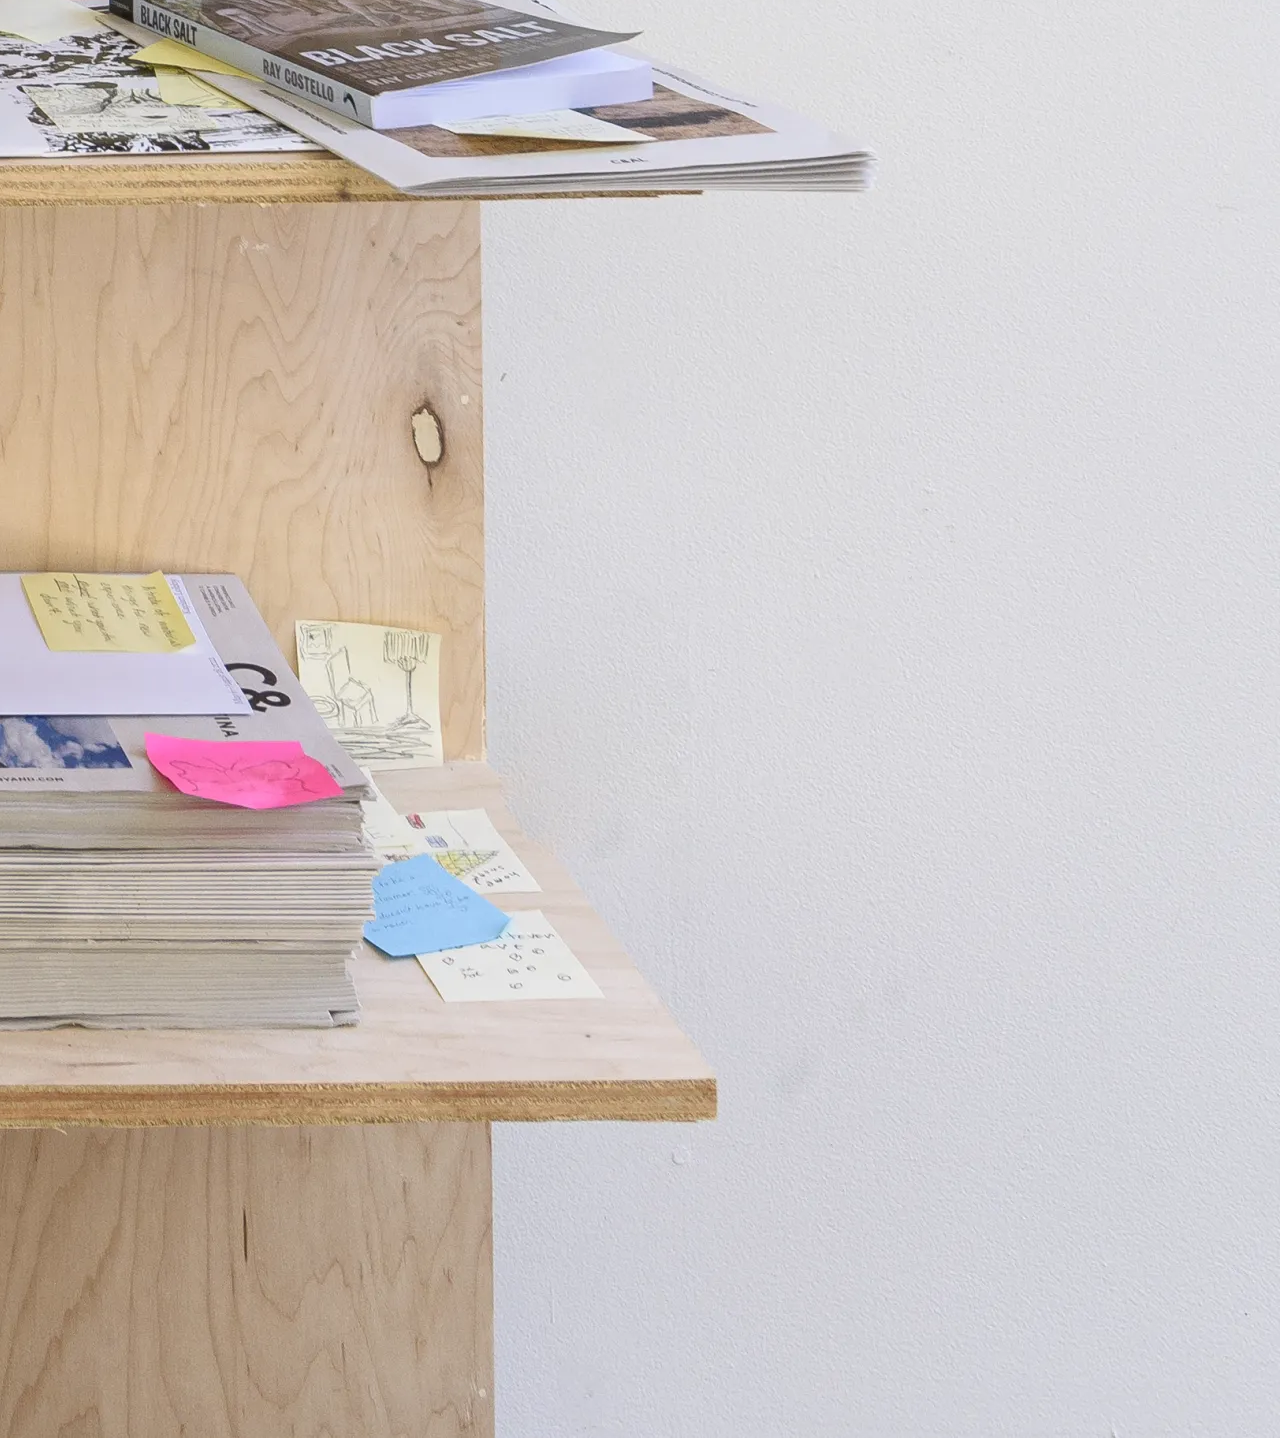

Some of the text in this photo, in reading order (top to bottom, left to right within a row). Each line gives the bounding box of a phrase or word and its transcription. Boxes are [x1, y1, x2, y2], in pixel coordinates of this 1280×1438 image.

[140, 5, 197, 47] BLACK SALT
[300, 21, 557, 66] BLACK SALT
[262, 59, 334, 103] RAY COSTELLO
